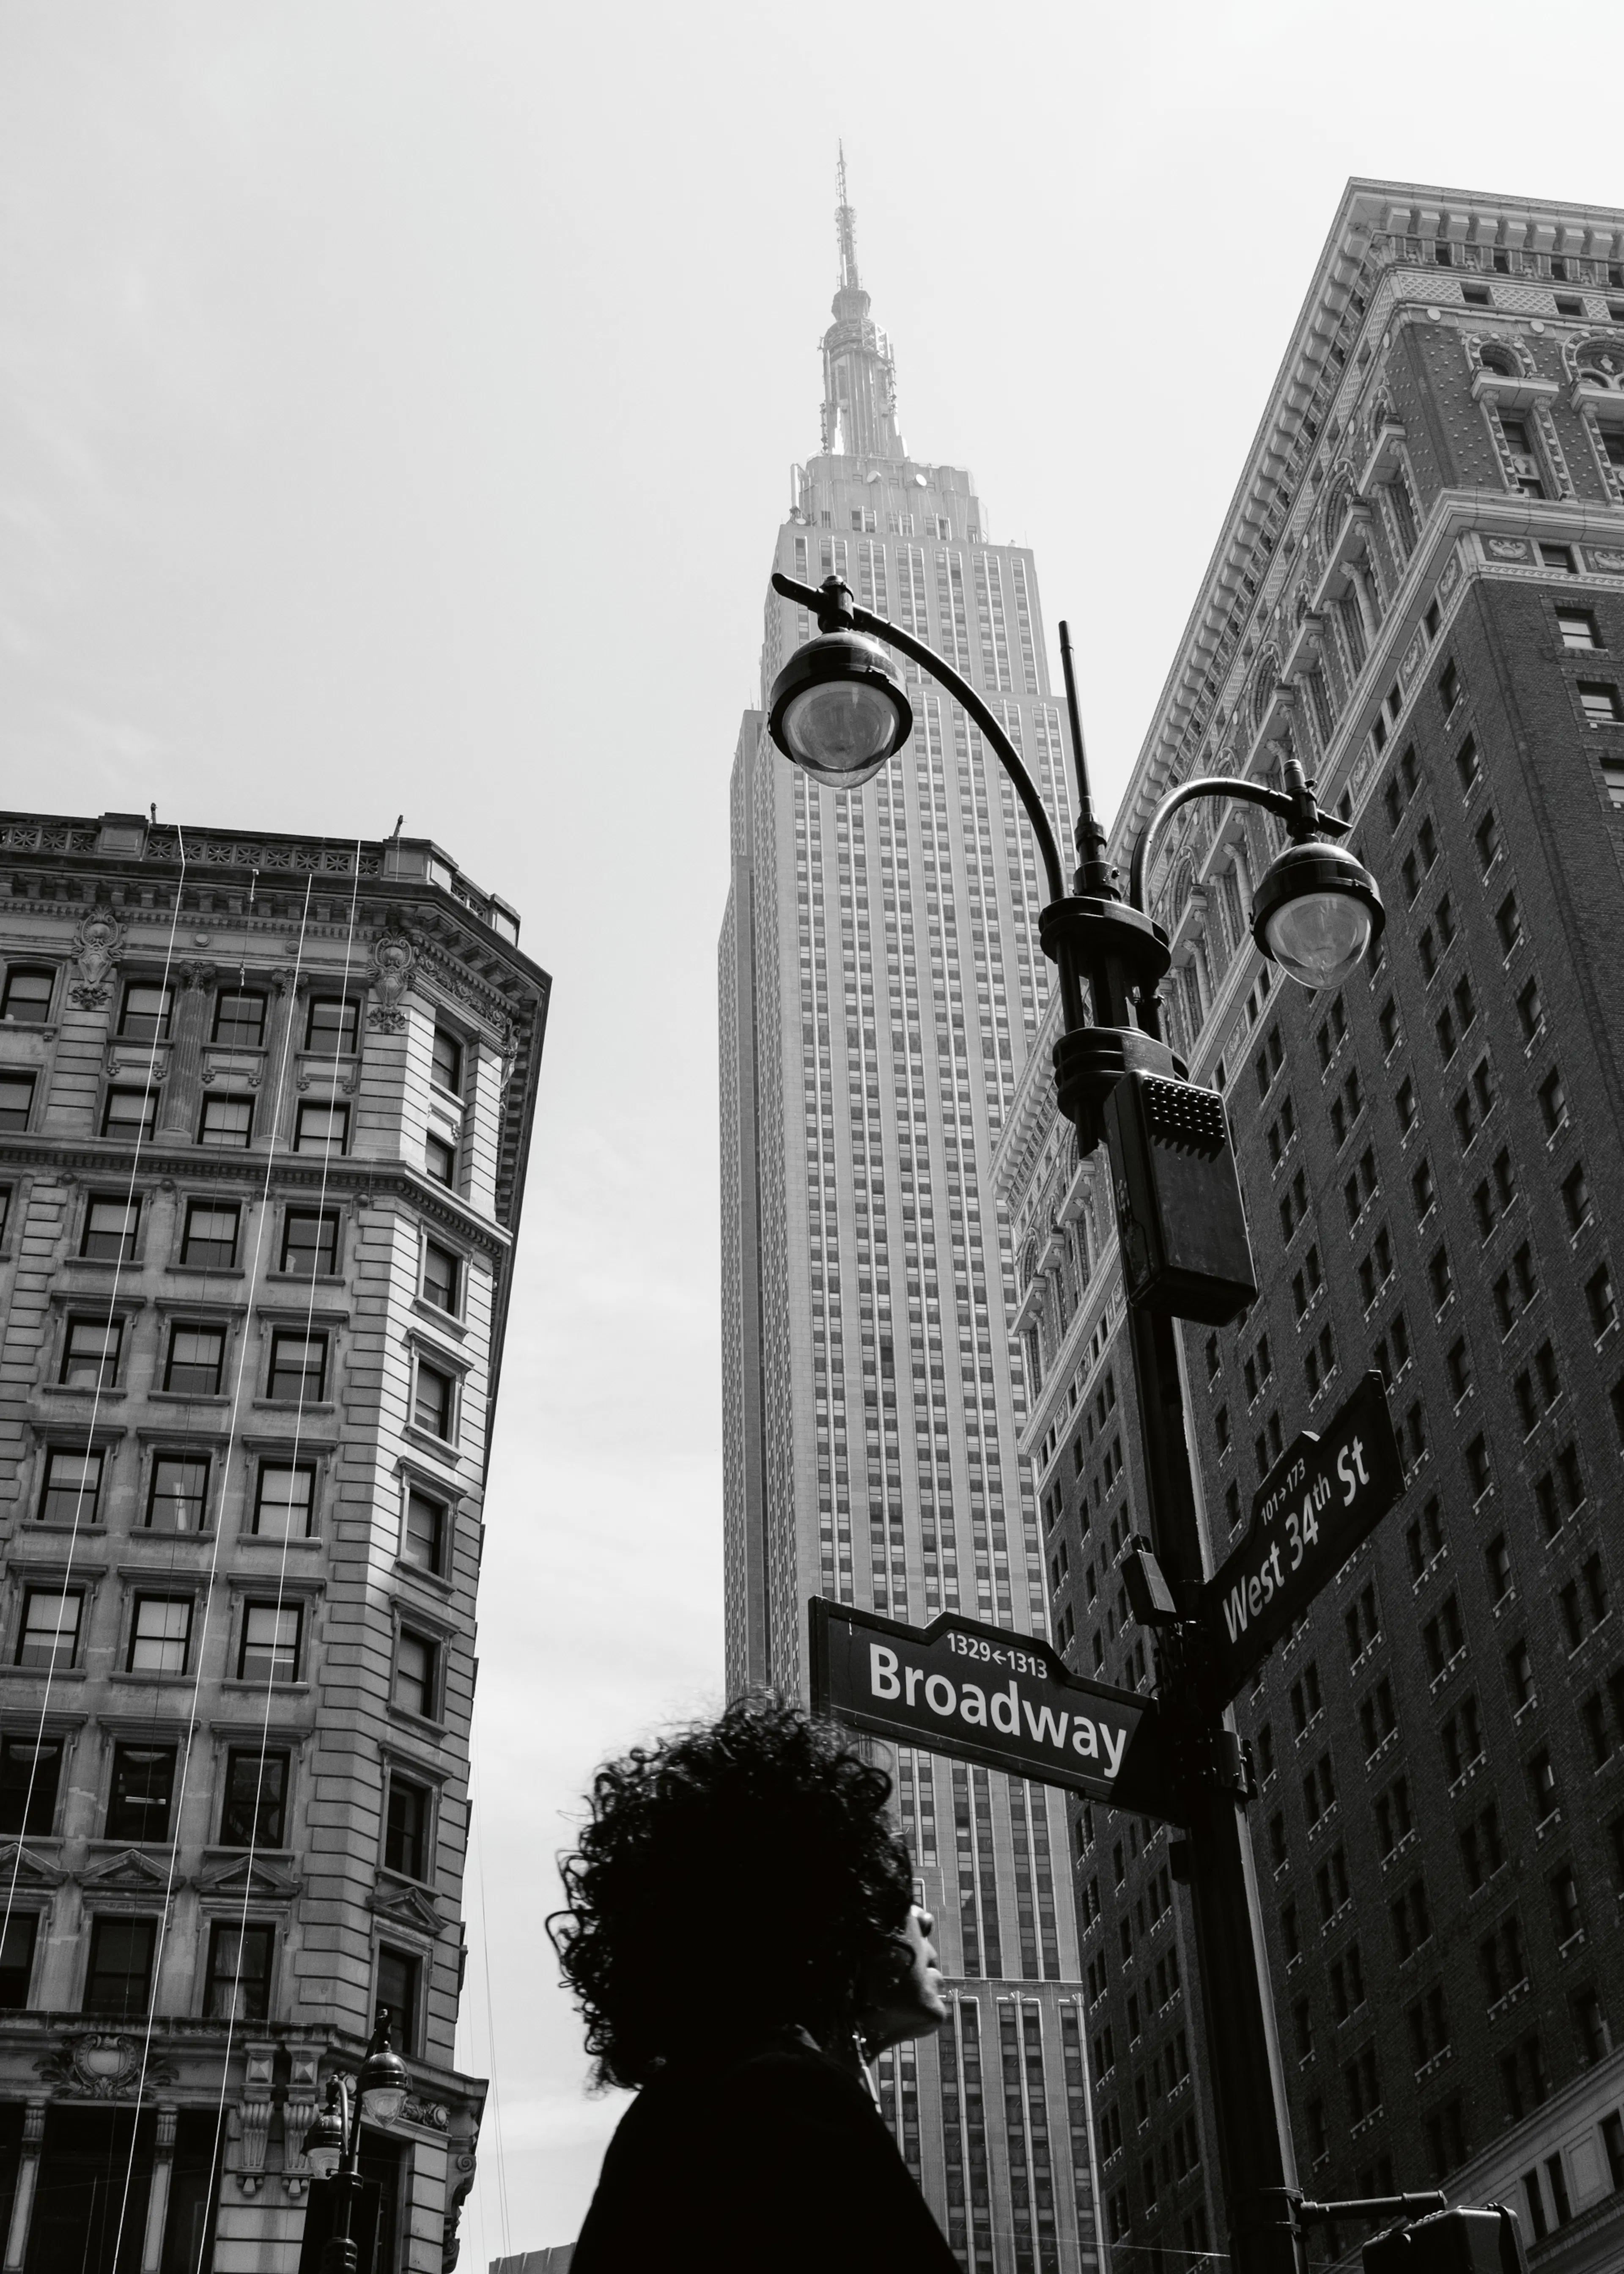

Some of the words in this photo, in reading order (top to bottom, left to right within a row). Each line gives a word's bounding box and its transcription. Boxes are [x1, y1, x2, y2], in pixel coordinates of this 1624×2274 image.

[1222, 1540, 1285, 1644] West
[1285, 1472, 1331, 1571] 34th
[1337, 1435, 1370, 1507] St
[1261, 1492, 1278, 1526] 101
[1286, 1458, 1306, 1492] 173
[947, 1632, 990, 1662] 1329
[1007, 1651, 1048, 1679] 1313
[870, 1642, 1127, 1778] Broadway
